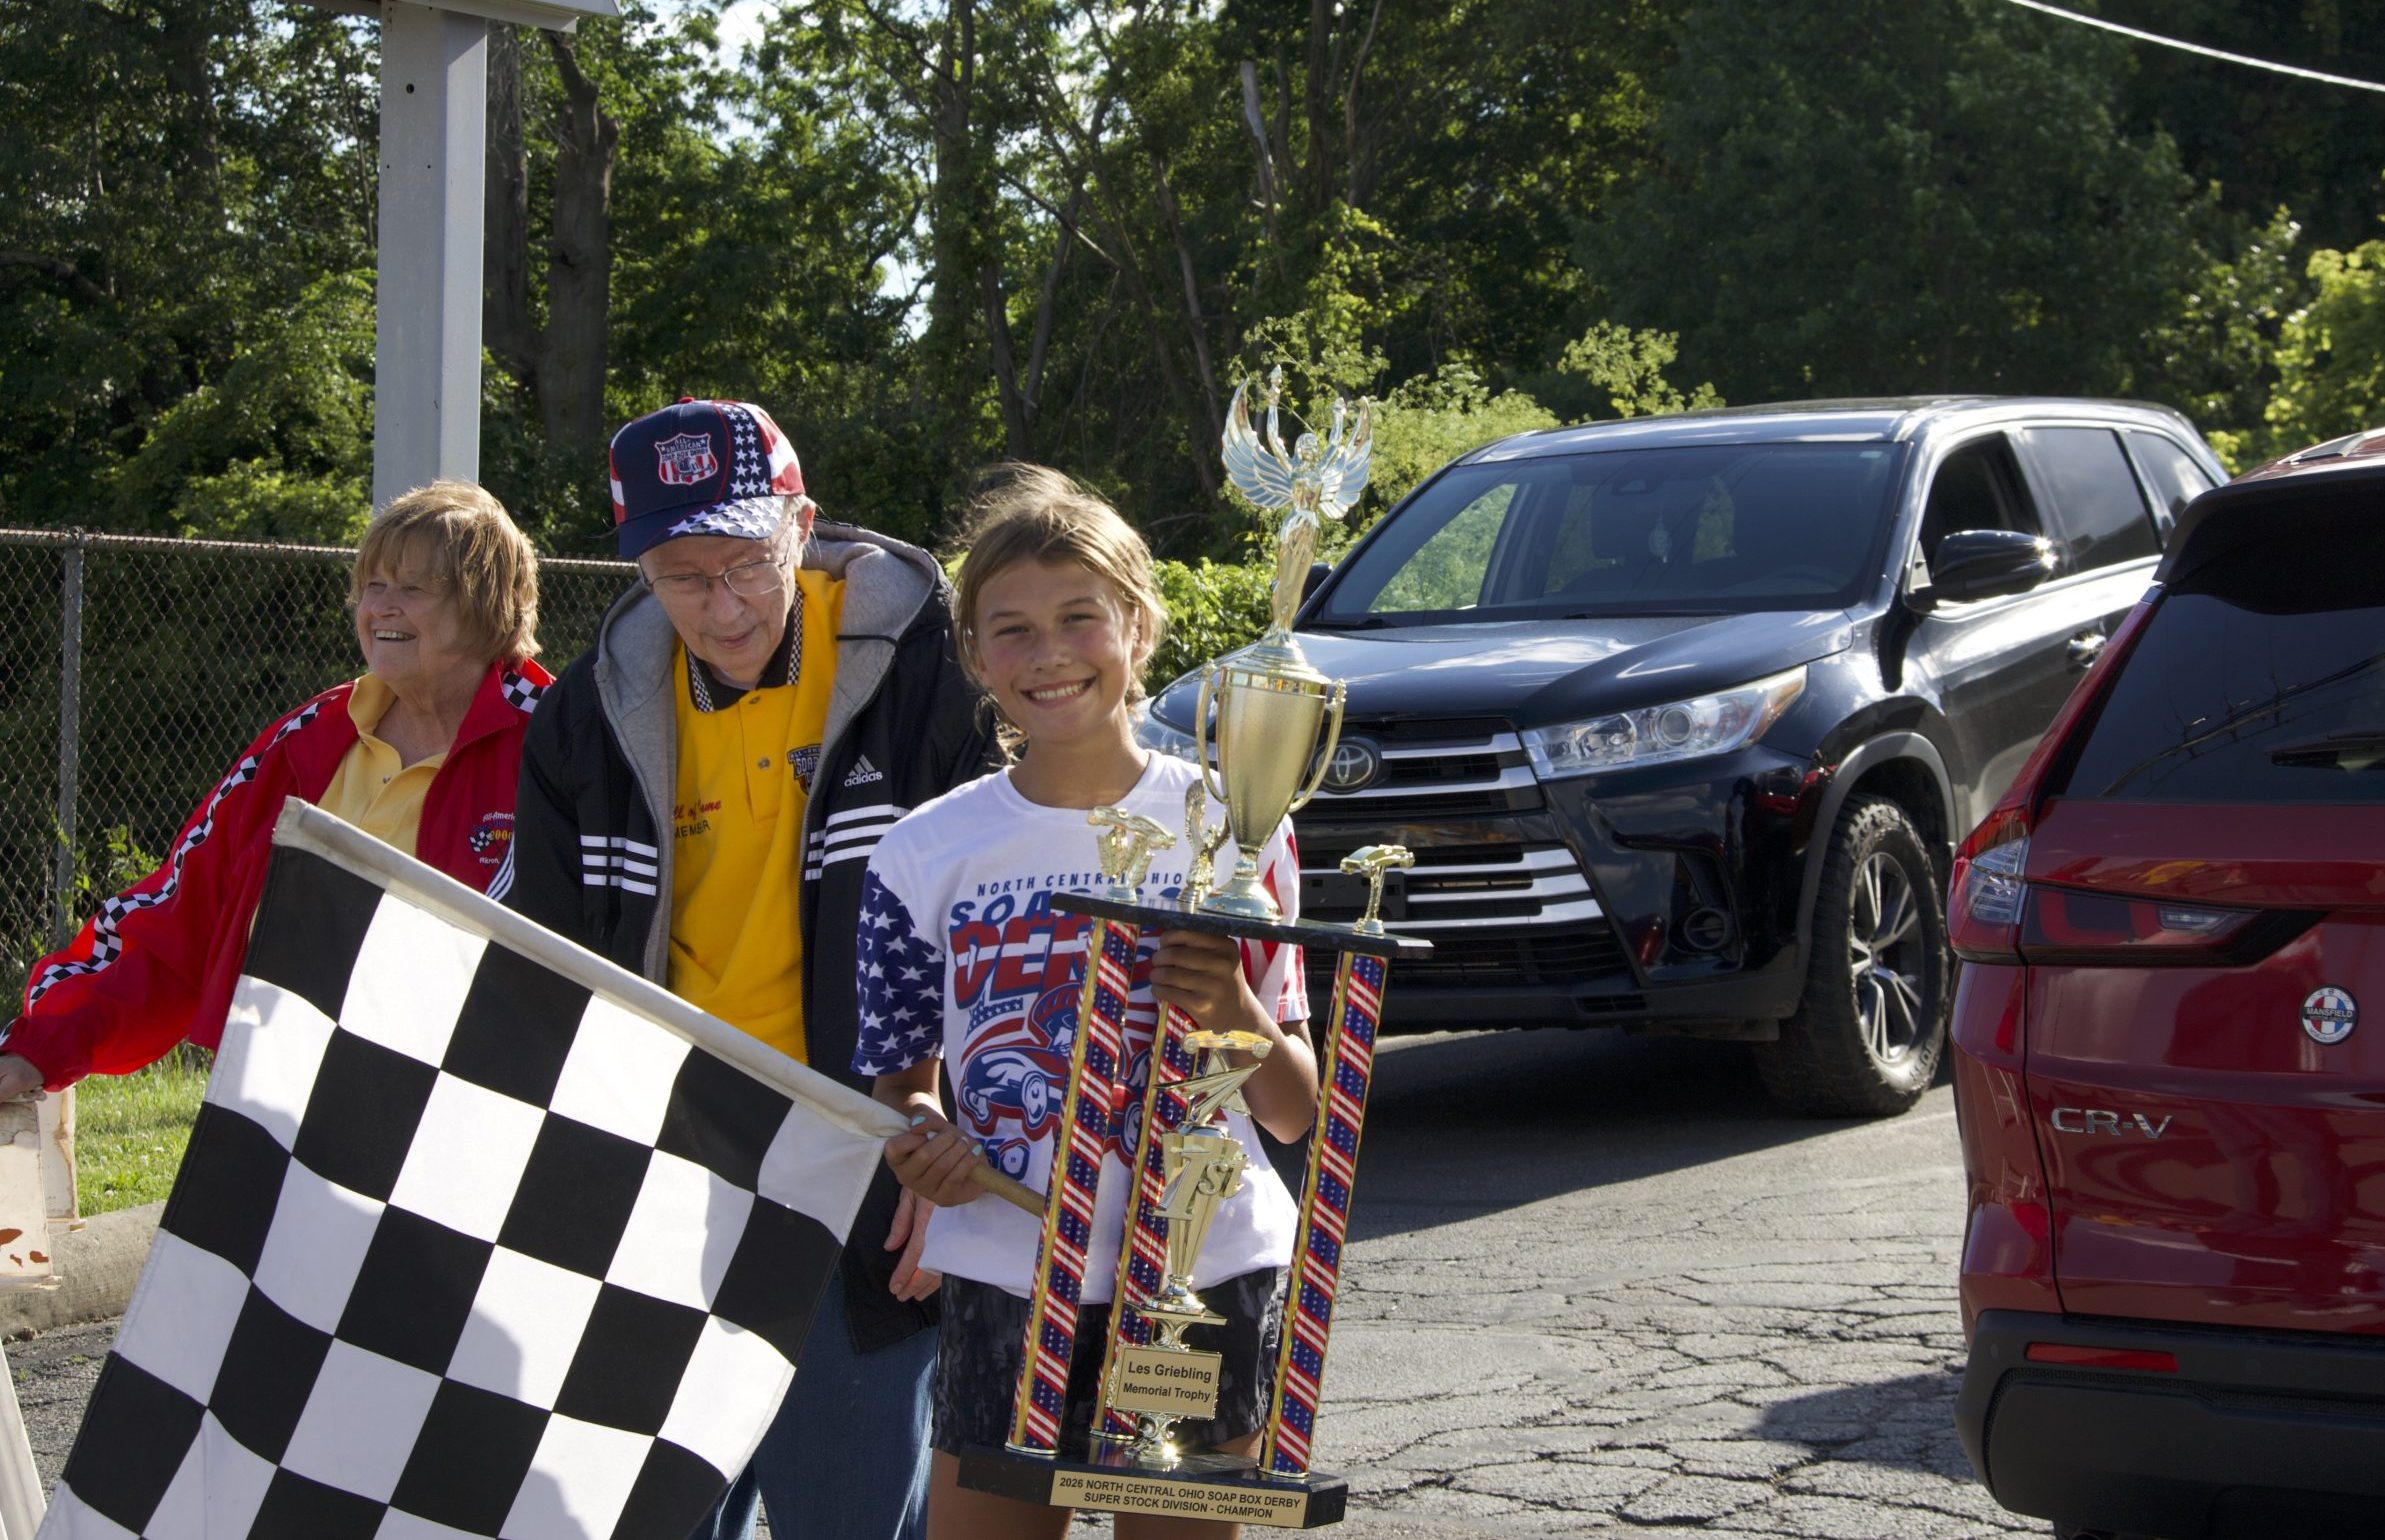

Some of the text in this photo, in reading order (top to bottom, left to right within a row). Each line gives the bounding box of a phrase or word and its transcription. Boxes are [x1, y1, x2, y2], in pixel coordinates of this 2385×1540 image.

[844, 771, 884, 787] adidas
[977, 876, 1036, 897] NORTH
[1143, 873, 1182, 884] HIO
[2307, 1007, 2353, 1018] MANSFIELD
[2051, 1107, 2173, 1139] CR-V
[1128, 1362, 1212, 1384] Les Griebling
[1123, 1382, 1211, 1403] Memorial Trophy
[1059, 1477, 1301, 1508] 2026 NORTH CENTRAL OHIO SOAP BOX DERBY
[1084, 1492, 1121, 1504] SUPER
[1122, 1496, 1159, 1508] STOCK
[1162, 1499, 1208, 1512] DIVISION
[1216, 1504, 1273, 1518] CHAMPION
